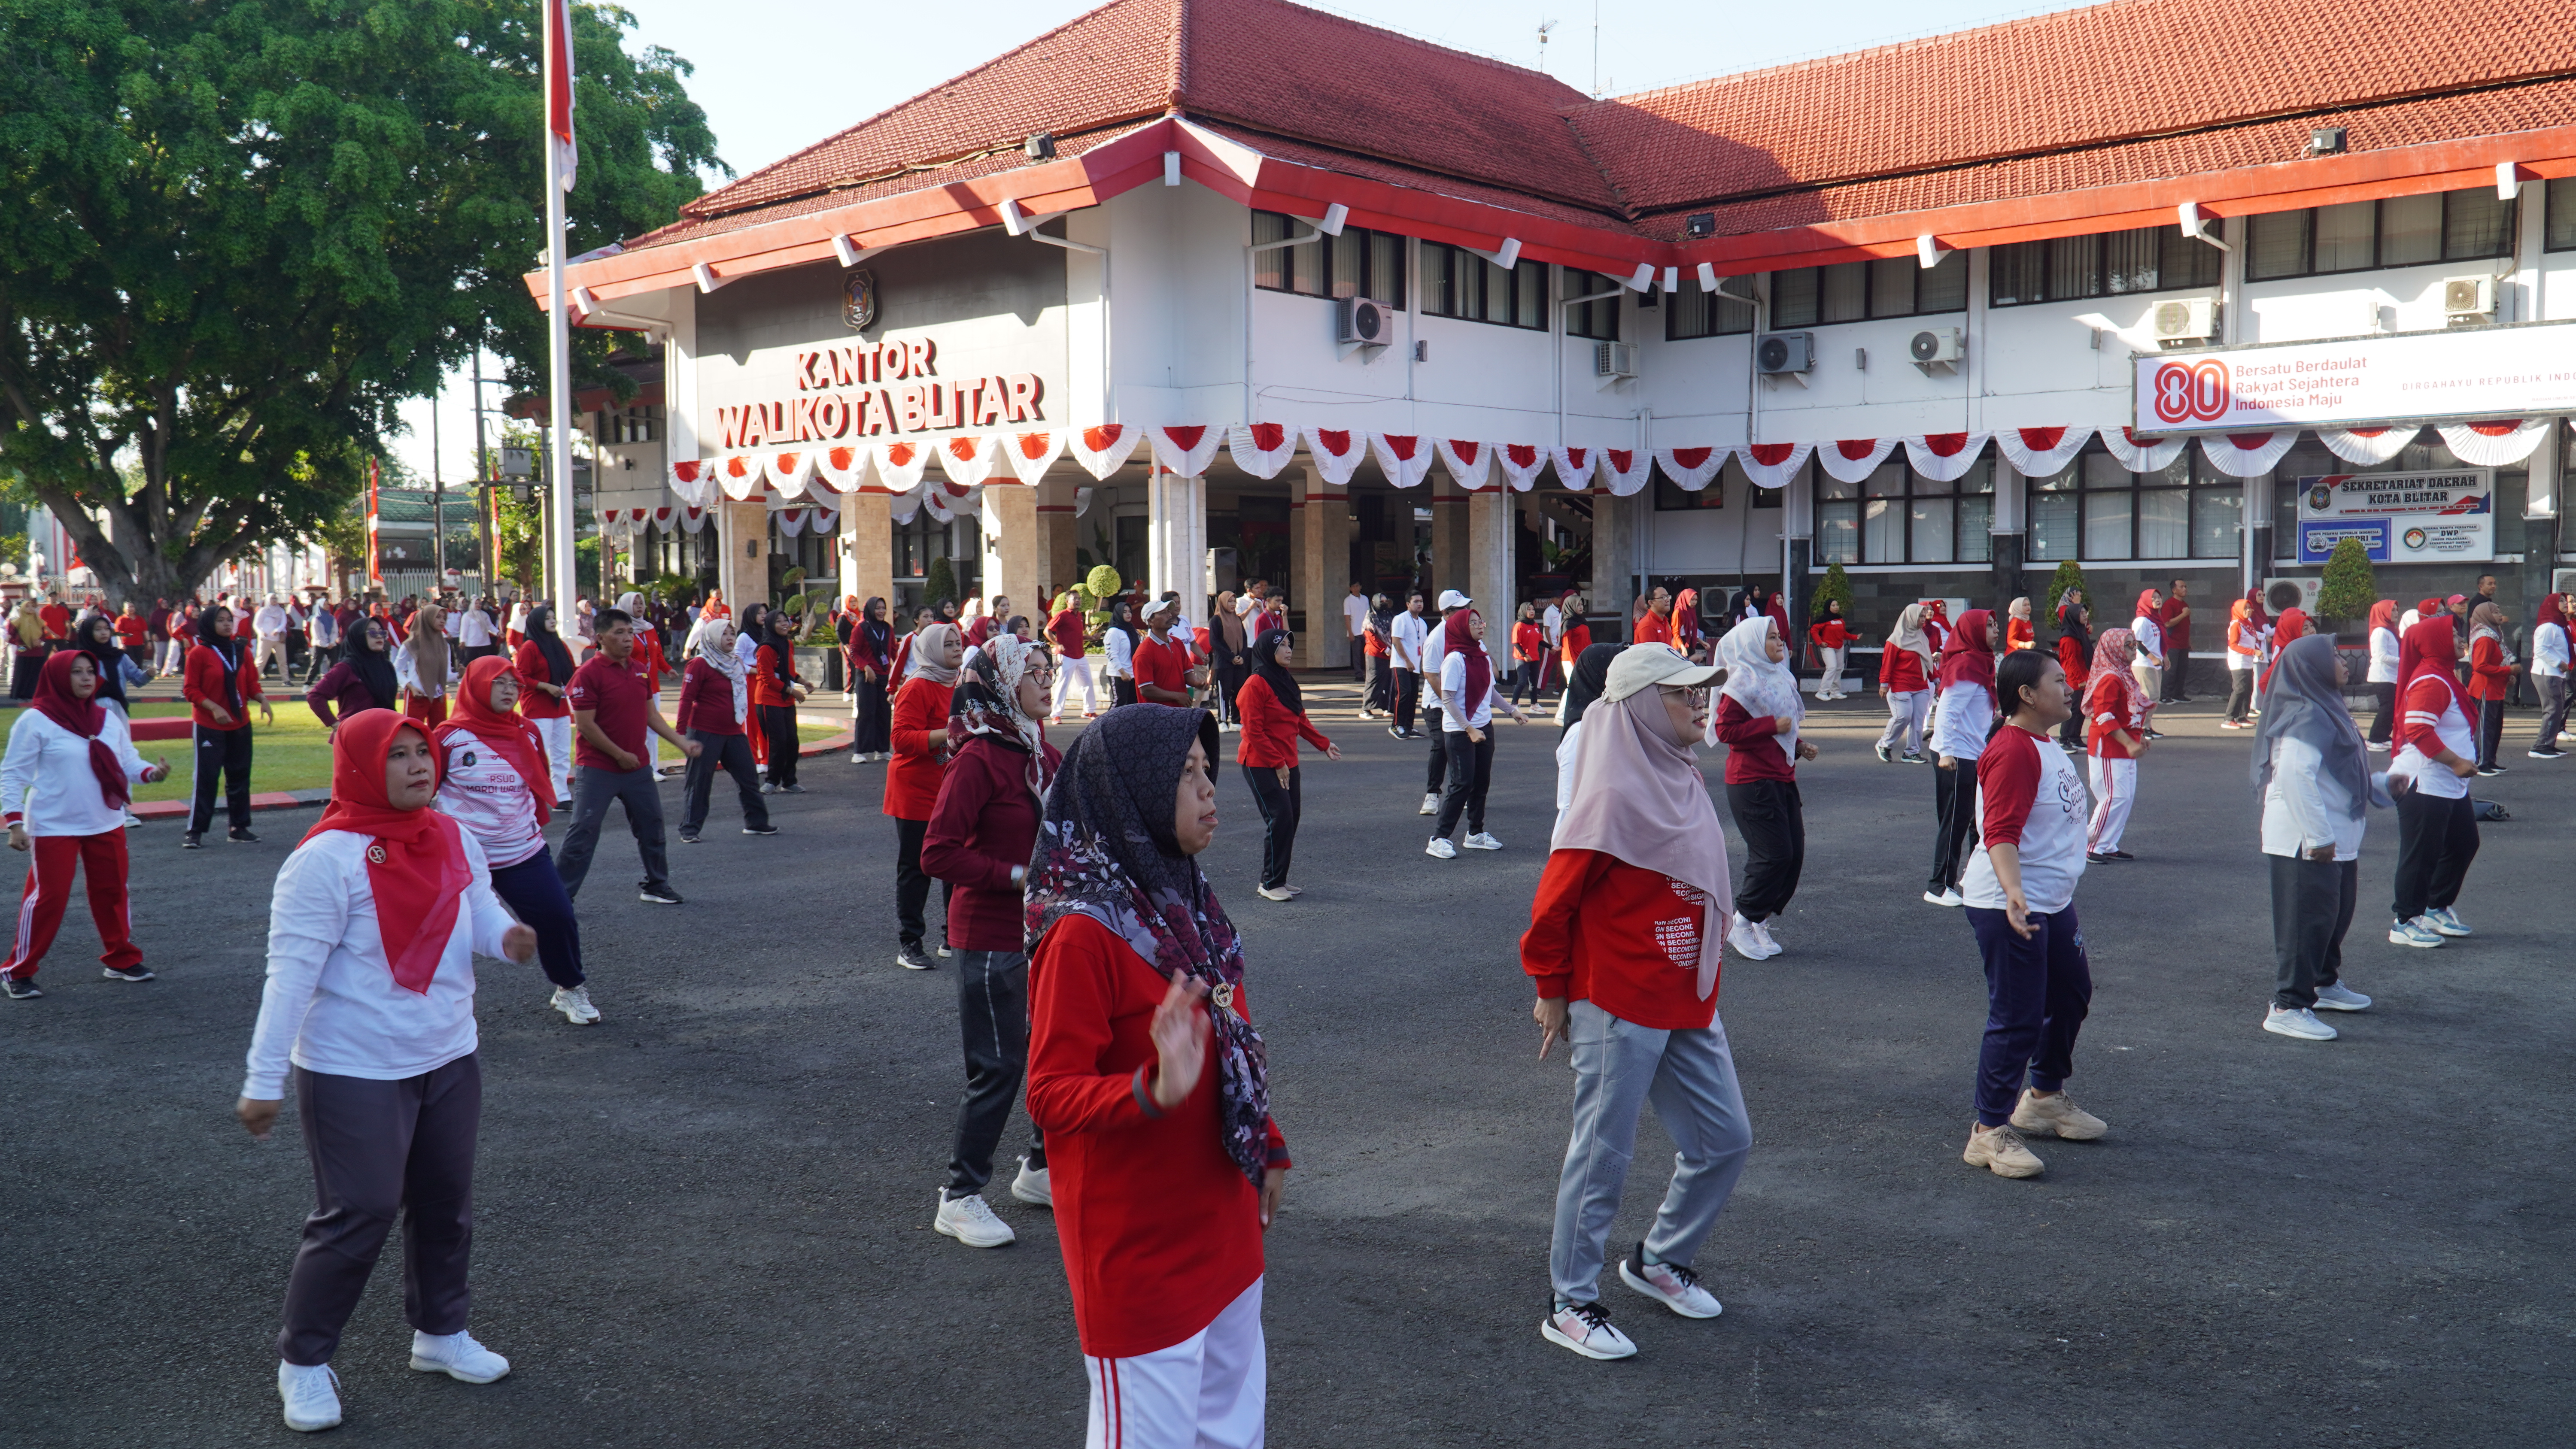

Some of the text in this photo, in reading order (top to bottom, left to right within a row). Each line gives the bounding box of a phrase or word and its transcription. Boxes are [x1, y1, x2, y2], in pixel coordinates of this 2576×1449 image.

[793, 337, 936, 389] KANTOR
[2236, 357, 2367, 377] Bersatu Berdaulat
[2154, 358, 2230, 424] 80
[2236, 376, 2360, 395] Rakyat Sejahtera
[2403, 379, 2472, 391] DIRGAHAYU
[2479, 374, 2542, 385] REPUBLIK
[713, 372, 1045, 448] WALIKOTA BLITAR
[2236, 393, 2342, 411] Indonesia Maju
[2342, 476, 2477, 492] SEKRETARIAT DAERAH
[2368, 491, 2448, 505] KOTA BLITAR
[490, 775, 515, 783] RSUD
[466, 785, 497, 793] MARDI
[1666, 923, 1694, 932] SECOND
